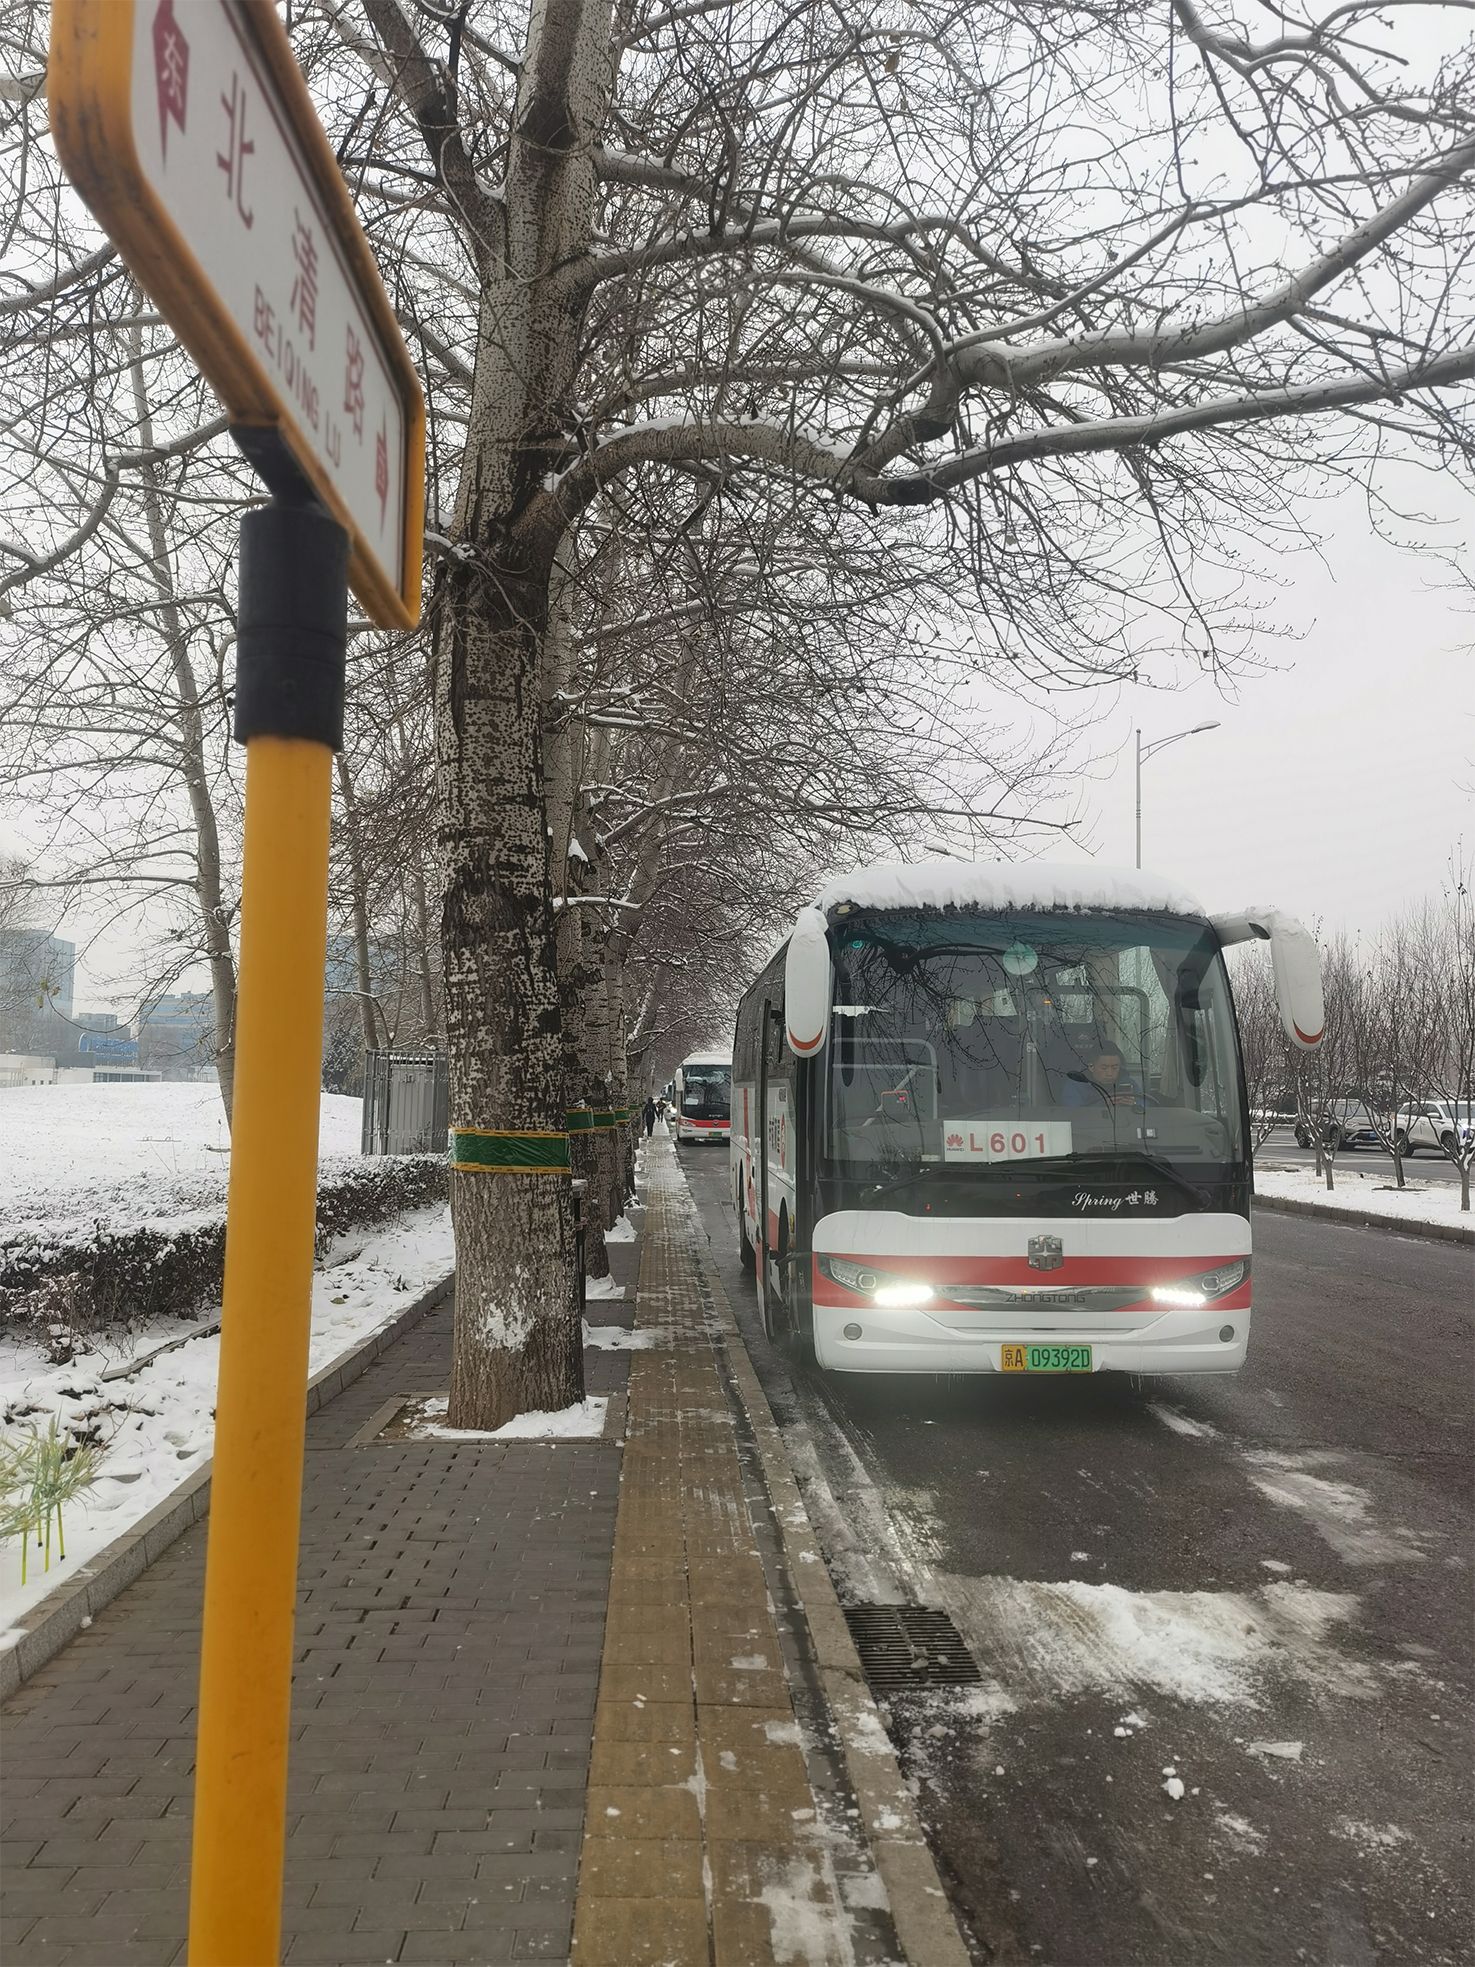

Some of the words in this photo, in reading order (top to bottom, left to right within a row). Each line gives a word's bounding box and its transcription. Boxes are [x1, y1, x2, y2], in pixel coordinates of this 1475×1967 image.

[216, 69, 364, 447] 北清路
[253, 282, 319, 433] BEIQING
[325, 409, 341, 469] LU
[969, 1132, 1045, 1154] L601
[1071, 1191, 1123, 1212] Spring
[1005, 1293, 1086, 1304] ZHONGTONG
